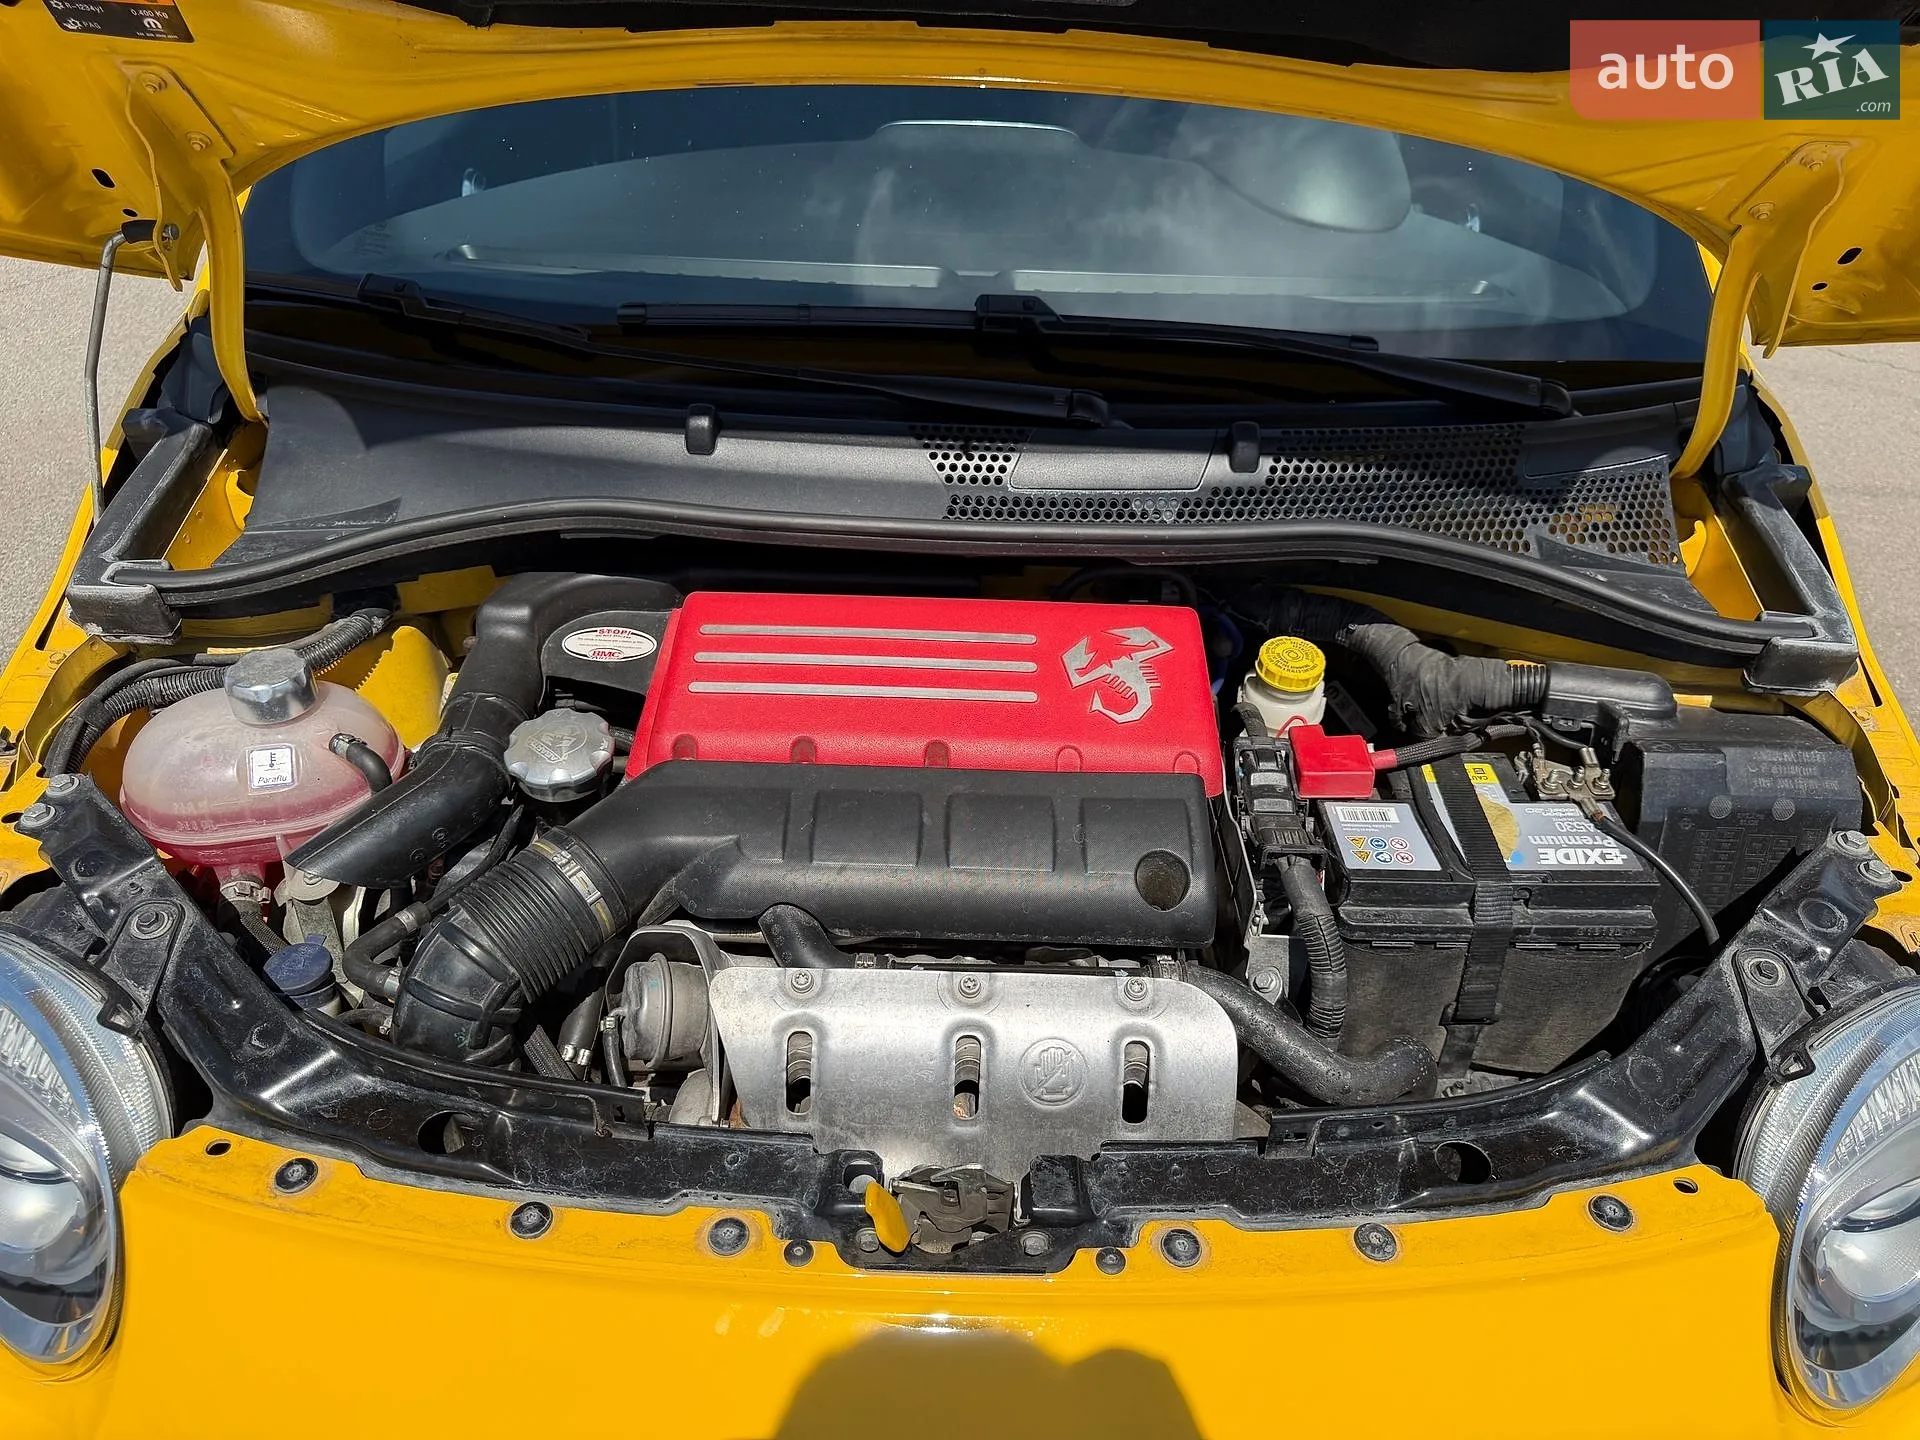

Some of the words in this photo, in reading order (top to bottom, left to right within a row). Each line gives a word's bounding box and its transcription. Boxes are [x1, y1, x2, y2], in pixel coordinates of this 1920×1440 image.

[258, 775, 287, 784] Paraflu
[1528, 836, 1617, 848] Premium
[1538, 848, 1627, 864] EXIDE
